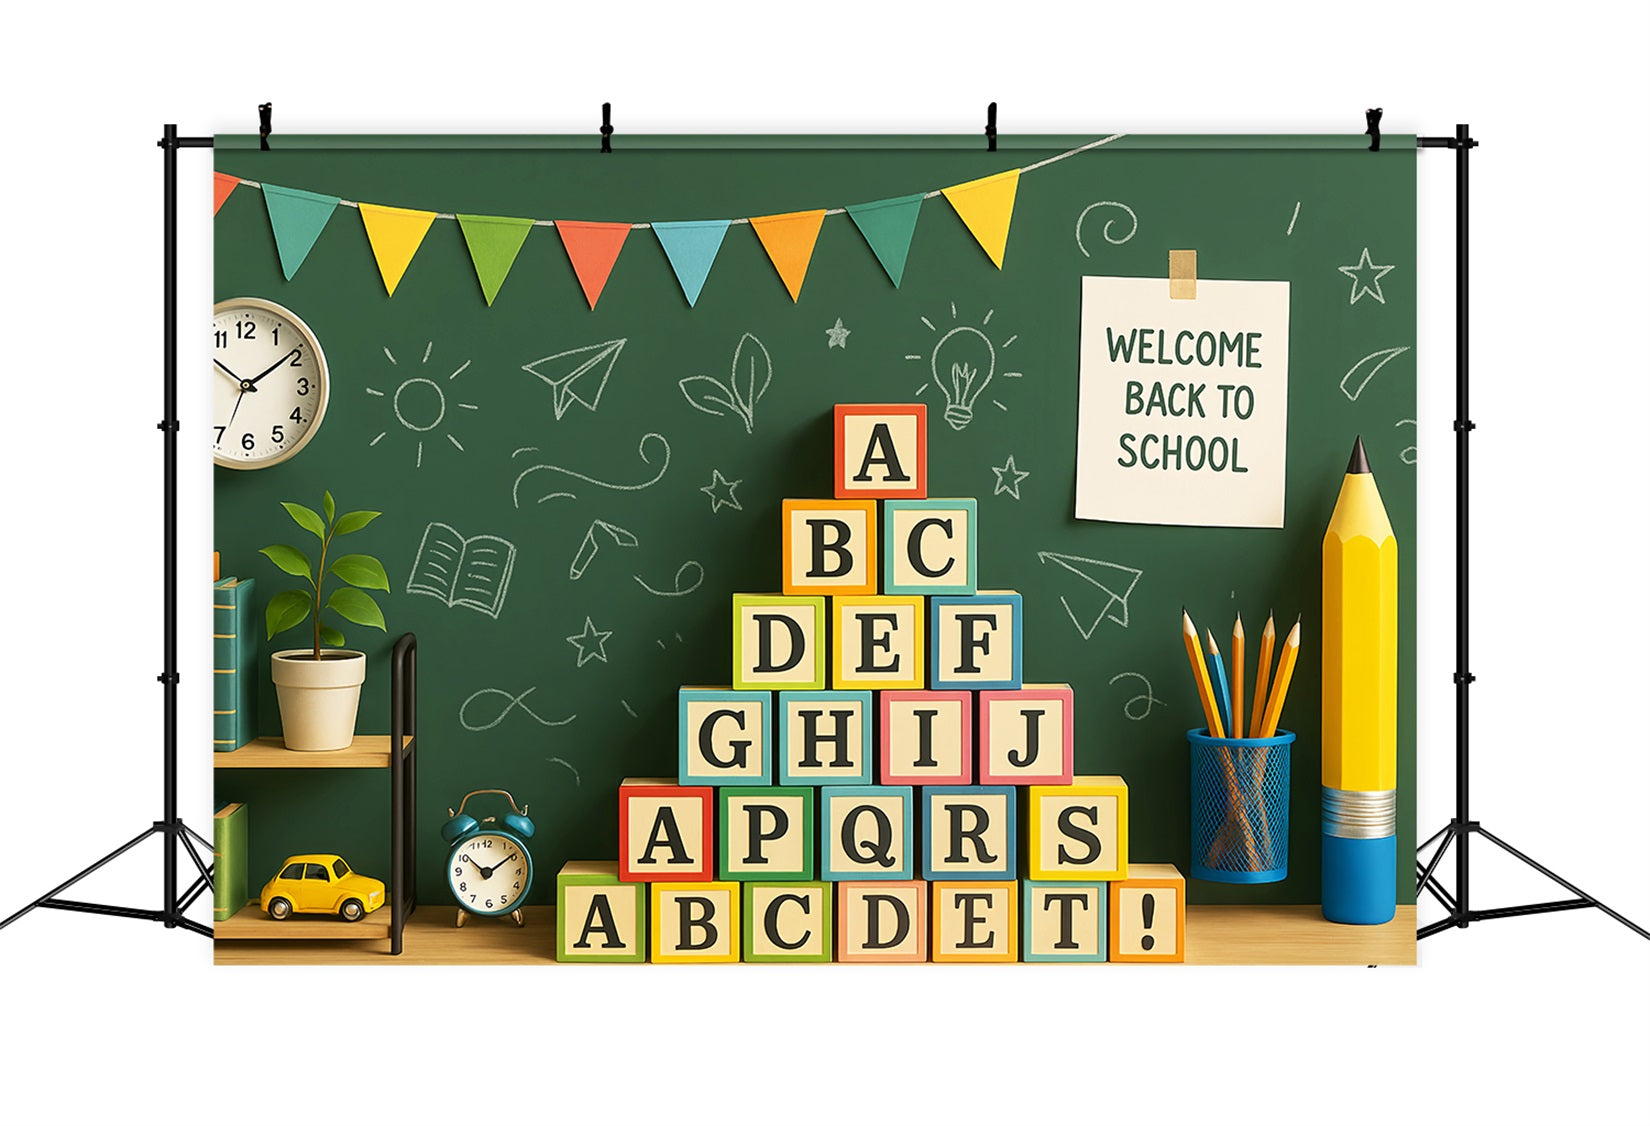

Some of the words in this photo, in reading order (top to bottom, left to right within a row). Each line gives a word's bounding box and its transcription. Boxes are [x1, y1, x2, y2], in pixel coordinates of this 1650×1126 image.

[214, 330, 228, 349] 11
[236, 321, 256, 340] 12
[272, 327, 279, 346] 1
[1107, 327, 1262, 368] WELCOME
[290, 348, 303, 367] 2
[297, 377, 309, 395] 3
[1126, 381, 1206, 418] BACK
[1217, 385, 1254, 420] TO
[290, 406, 302, 424] 4
[214, 426, 227, 445] 7
[242, 433, 256, 450] 6
[271, 425, 285, 443] 5
[853, 424, 910, 481] A
[1118, 433, 1248, 472] SCHOOL
[806, 520, 853, 577] B
[907, 519, 954, 577] C
[753, 615, 805, 672] D
[856, 614, 899, 672] E
[954, 614, 997, 673] F
[699, 710, 752, 768] G
[798, 711, 853, 767] H
[914, 710, 937, 766] I
[1008, 710, 1045, 767] J
[638, 807, 694, 863] A
[743, 805, 788, 863] P
[841, 805, 895, 867] Q
[945, 805, 997, 863] R
[1058, 806, 1101, 864] S
[454, 867, 462, 876] 9
[460, 881, 468, 892] 8
[513, 881, 520, 889] 4
[470, 894, 477, 903] 7
[485, 899, 493, 908] 6
[501, 895, 508, 905] 5
[573, 895, 626, 948] A
[675, 897, 717, 950] B
[764, 894, 811, 949] C
[862, 895, 909, 948] D
[955, 894, 994, 948] E
[1044, 894, 1088, 948] T
[1142, 894, 1154, 950] !
